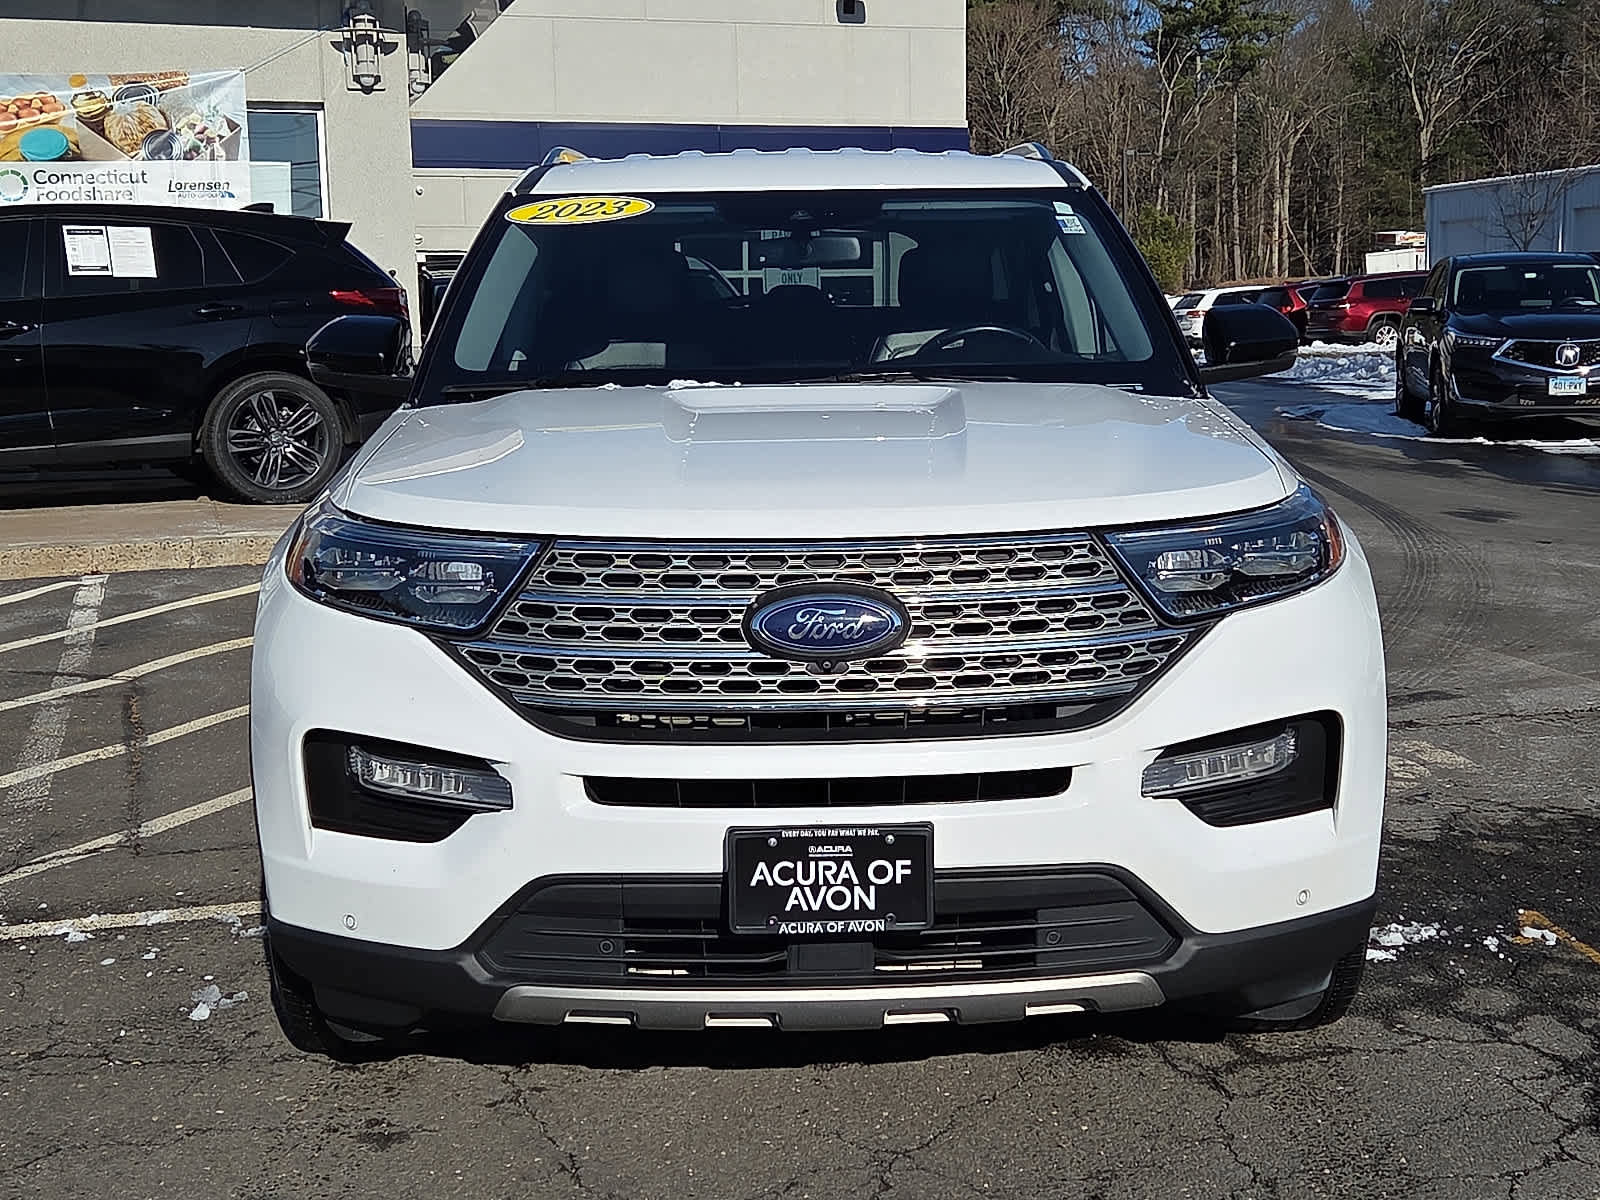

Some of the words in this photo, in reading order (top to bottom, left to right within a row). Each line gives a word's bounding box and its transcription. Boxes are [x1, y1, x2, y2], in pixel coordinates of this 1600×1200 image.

[33, 169, 148, 185] Connecticut
[167, 179, 230, 192] Lorensen
[35, 186, 134, 201] Foodshare
[528, 200, 632, 220] 2023
[781, 272, 803, 284] ONLY
[788, 608, 865, 640] Ford
[782, 830, 799, 838] EVERY
[814, 829, 827, 837] YOU
[828, 829, 839, 837] PAY
[839, 828, 856, 837] WHAT
[857, 828, 867, 837] WE
[816, 845, 853, 853] ACURA
[750, 861, 859, 886] ACURA
[867, 859, 912, 885] OF
[784, 885, 876, 911] AVON
[778, 921, 824, 934] ACURA
[826, 921, 845, 934] OF
[848, 919, 885, 933] AVON
